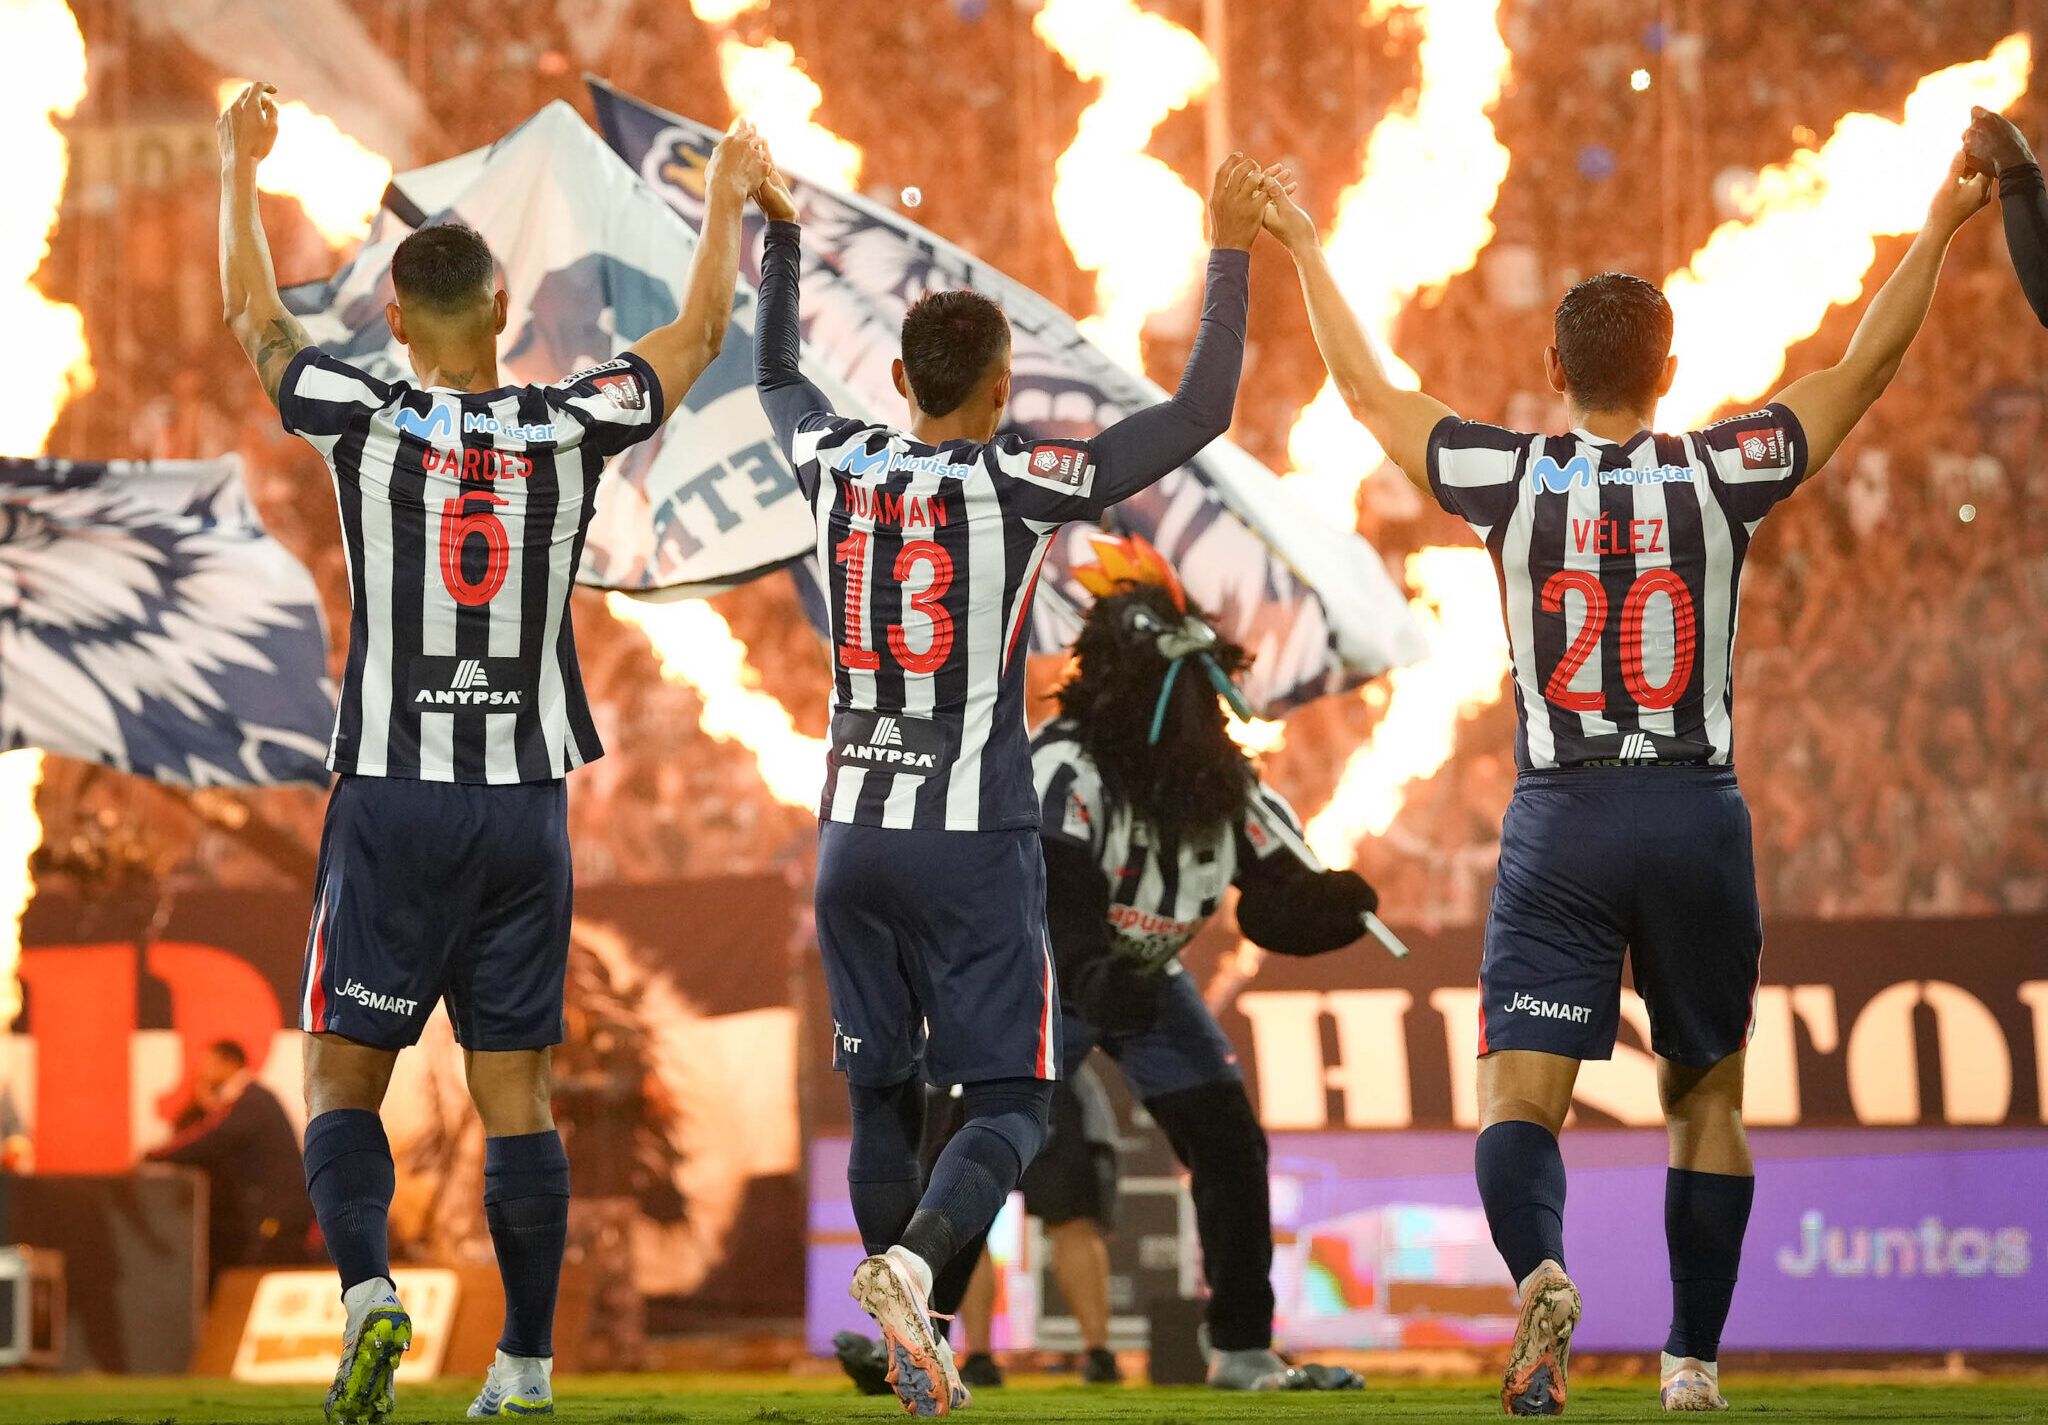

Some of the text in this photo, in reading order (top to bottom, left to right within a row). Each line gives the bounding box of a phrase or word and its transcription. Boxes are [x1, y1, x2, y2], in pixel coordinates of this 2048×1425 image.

[1601, 465, 1694, 484] Movistar
[843, 481, 947, 528] HUAMAN
[440, 491, 509, 606] 6
[1572, 511, 1664, 555] VÉLEZ
[835, 530, 954, 674] 13
[1541, 568, 1696, 711] 20
[335, 978, 418, 1016] JetSMART
[1504, 991, 1593, 1024] JetSMART
[1776, 1210, 2032, 1278] Juntos
